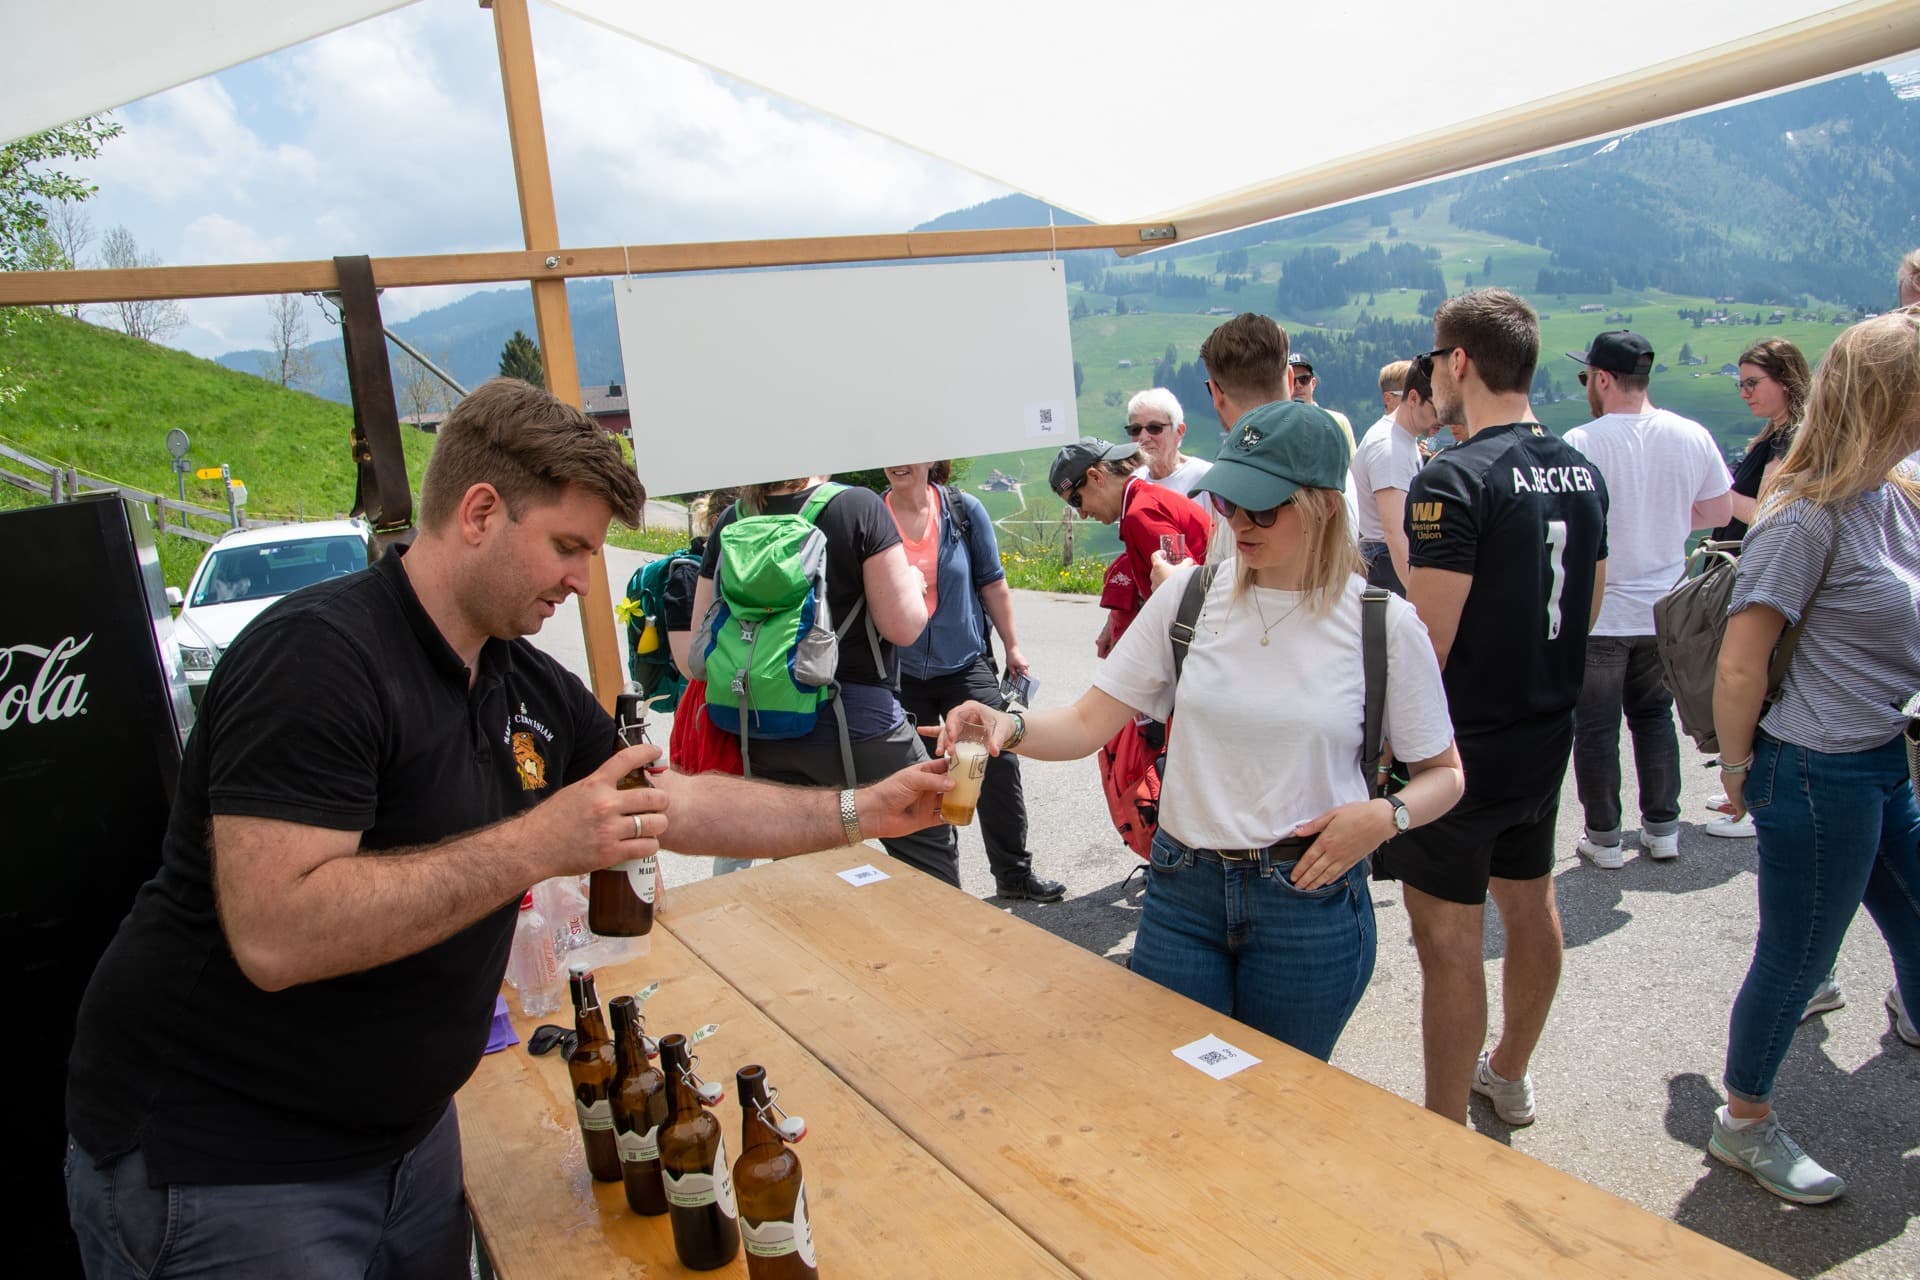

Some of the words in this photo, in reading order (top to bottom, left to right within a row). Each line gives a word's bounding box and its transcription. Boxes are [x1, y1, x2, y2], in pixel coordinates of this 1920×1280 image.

[1512, 466, 1596, 494] A.BECKER
[1411, 522, 1440, 531] Western
[1418, 531, 1442, 540] Union
[1546, 520, 1567, 640] 1
[0, 632, 93, 730] ola
